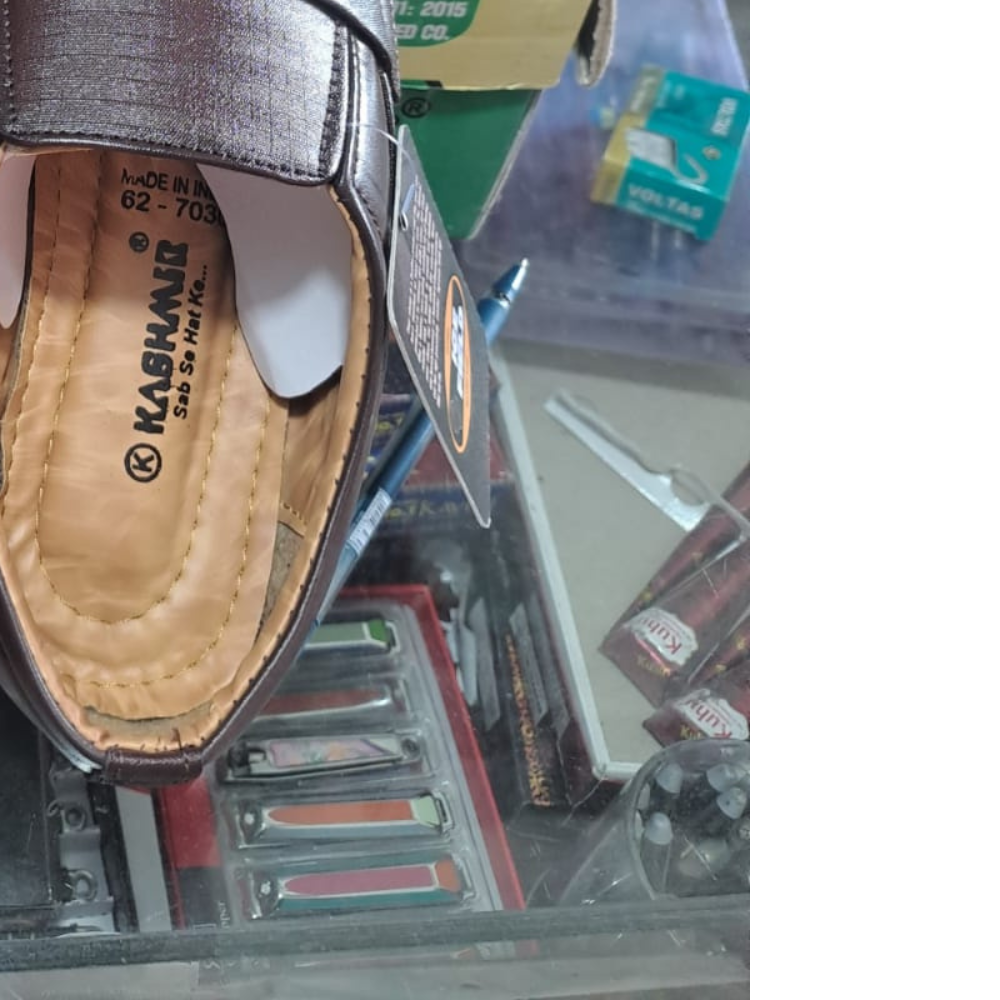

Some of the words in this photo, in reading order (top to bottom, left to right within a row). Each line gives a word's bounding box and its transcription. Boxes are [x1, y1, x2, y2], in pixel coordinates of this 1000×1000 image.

[419, 0, 469, 18] 2015
[420, 23, 450, 41] CO.
[121, 167, 168, 191] MADE
[173, 175, 189, 196] IN
[121, 189, 151, 212] 62
[627, 184, 705, 220] VOLTAS
[133, 239, 189, 435] KASHMIR
[184, 310, 202, 345] Hat
[179, 350, 196, 376] Se
[173, 381, 191, 420] Sab
